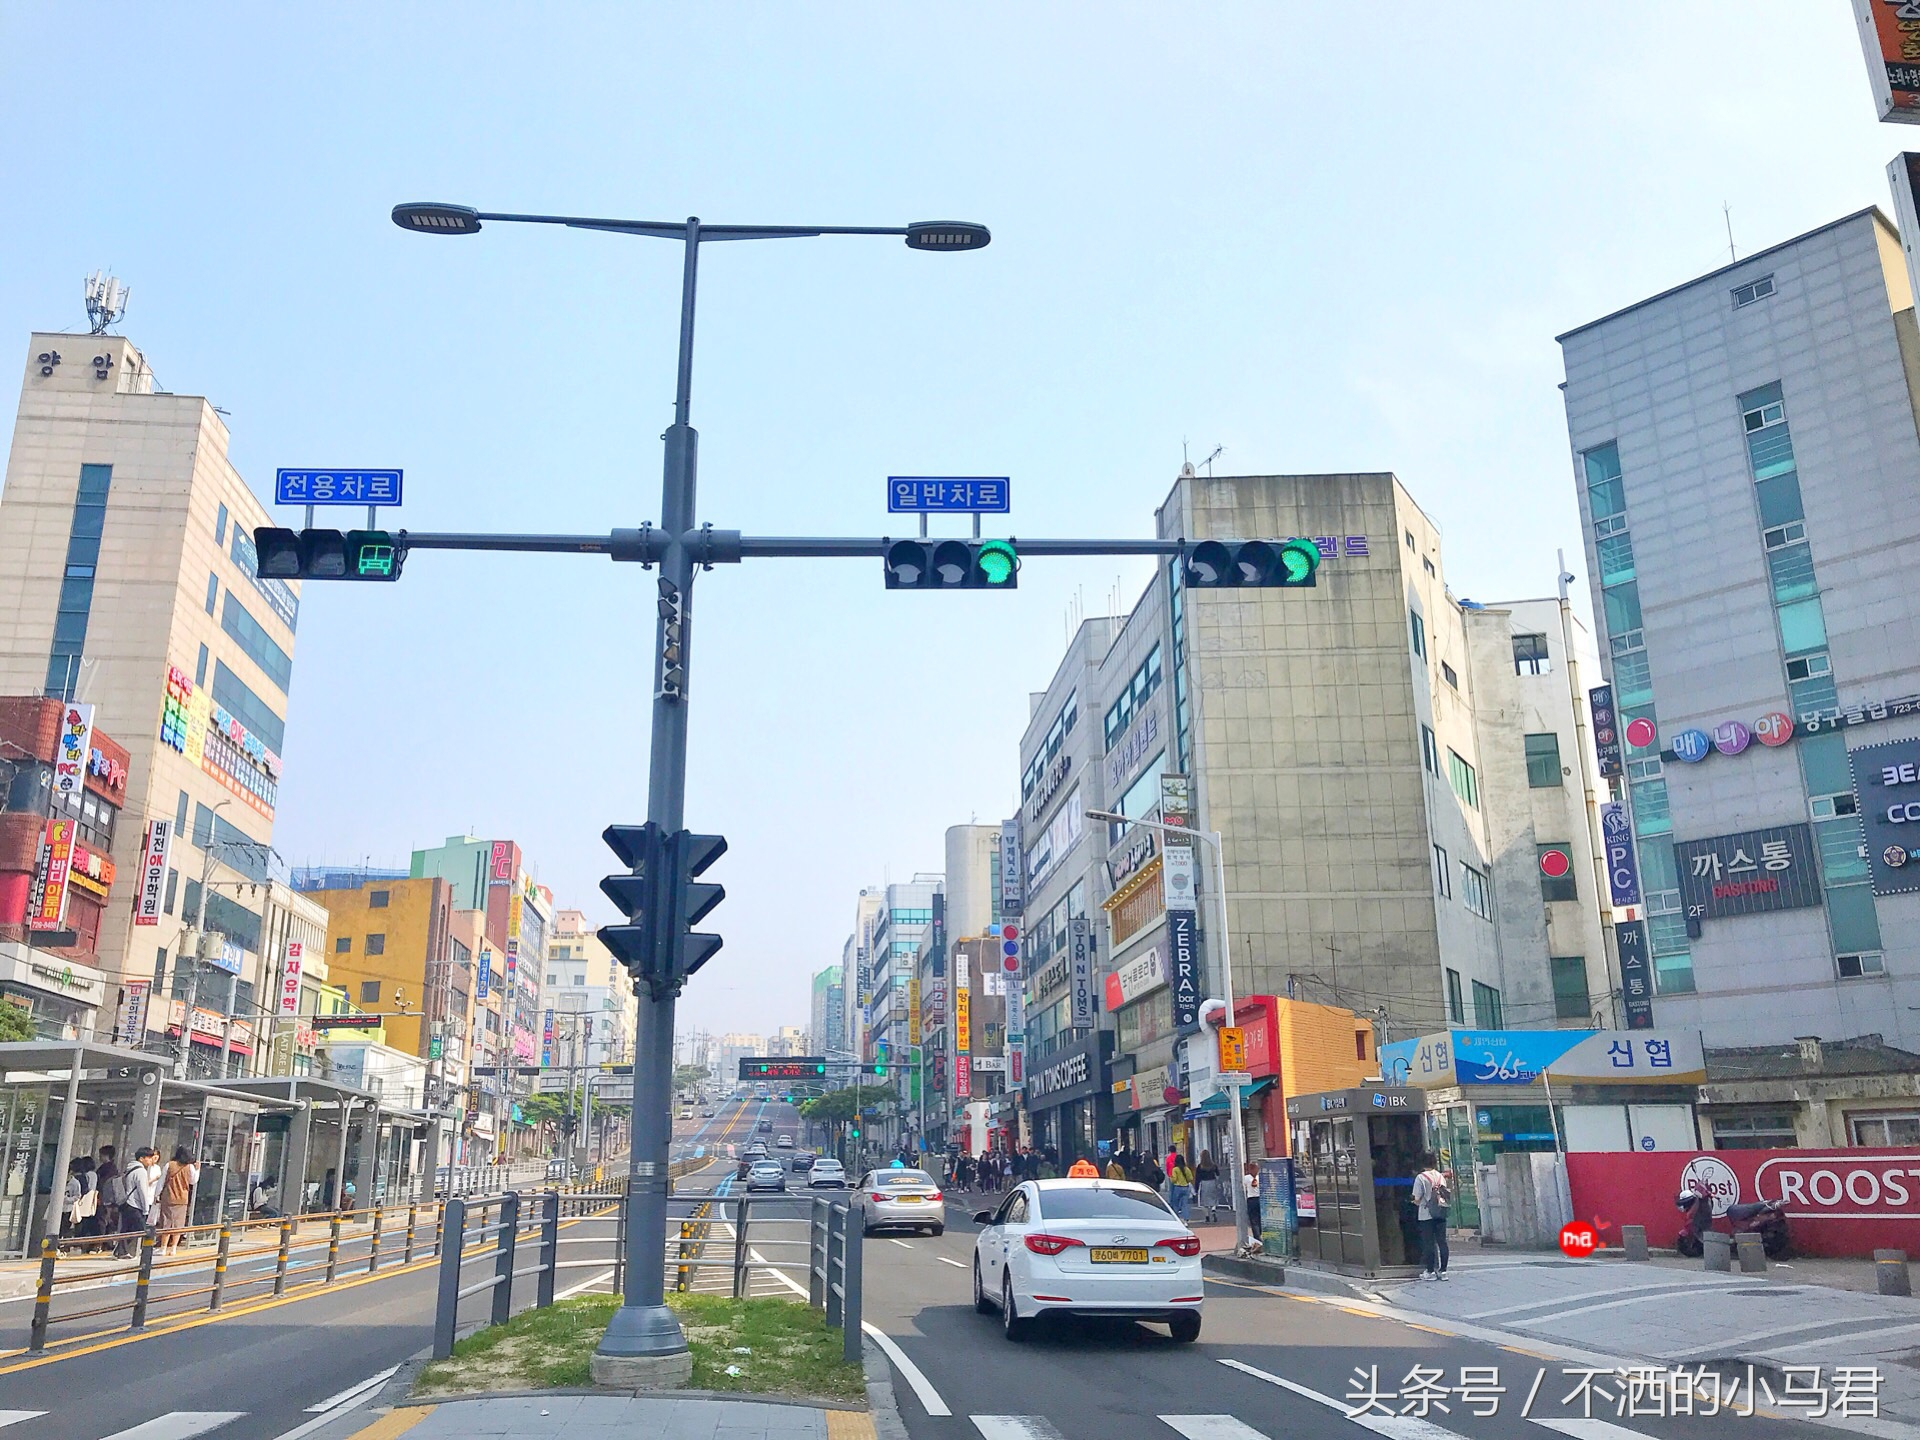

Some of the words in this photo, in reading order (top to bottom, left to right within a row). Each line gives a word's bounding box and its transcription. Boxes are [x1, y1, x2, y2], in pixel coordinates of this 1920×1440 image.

[285, 474, 392, 499] 전용차로
[896, 483, 1000, 506] 일반차로
[1673, 713, 1784, 757] 매니아
[1606, 834, 1629, 844] KING
[491, 842, 511, 878] PC
[1611, 847, 1631, 889] PC
[1692, 840, 1792, 881] 까스통
[1005, 887, 1019, 896] PC
[1712, 878, 1778, 898] GASTONG
[1689, 904, 1705, 917] 2F
[1075, 934, 1086, 961] TOM
[1176, 918, 1194, 992] ZEBRA
[1076, 965, 1085, 973] N
[1623, 930, 1645, 995] 까스통
[1076, 979, 1087, 1016] TOMS
[1178, 993, 1195, 1002] bar
[1420, 1041, 1450, 1073] 신협
[1475, 1051, 1527, 1080] 365
[1607, 1039, 1672, 1069] 신협
[1061, 1052, 1087, 1088] COFFEE
[1389, 1096, 1408, 1107] IBK
